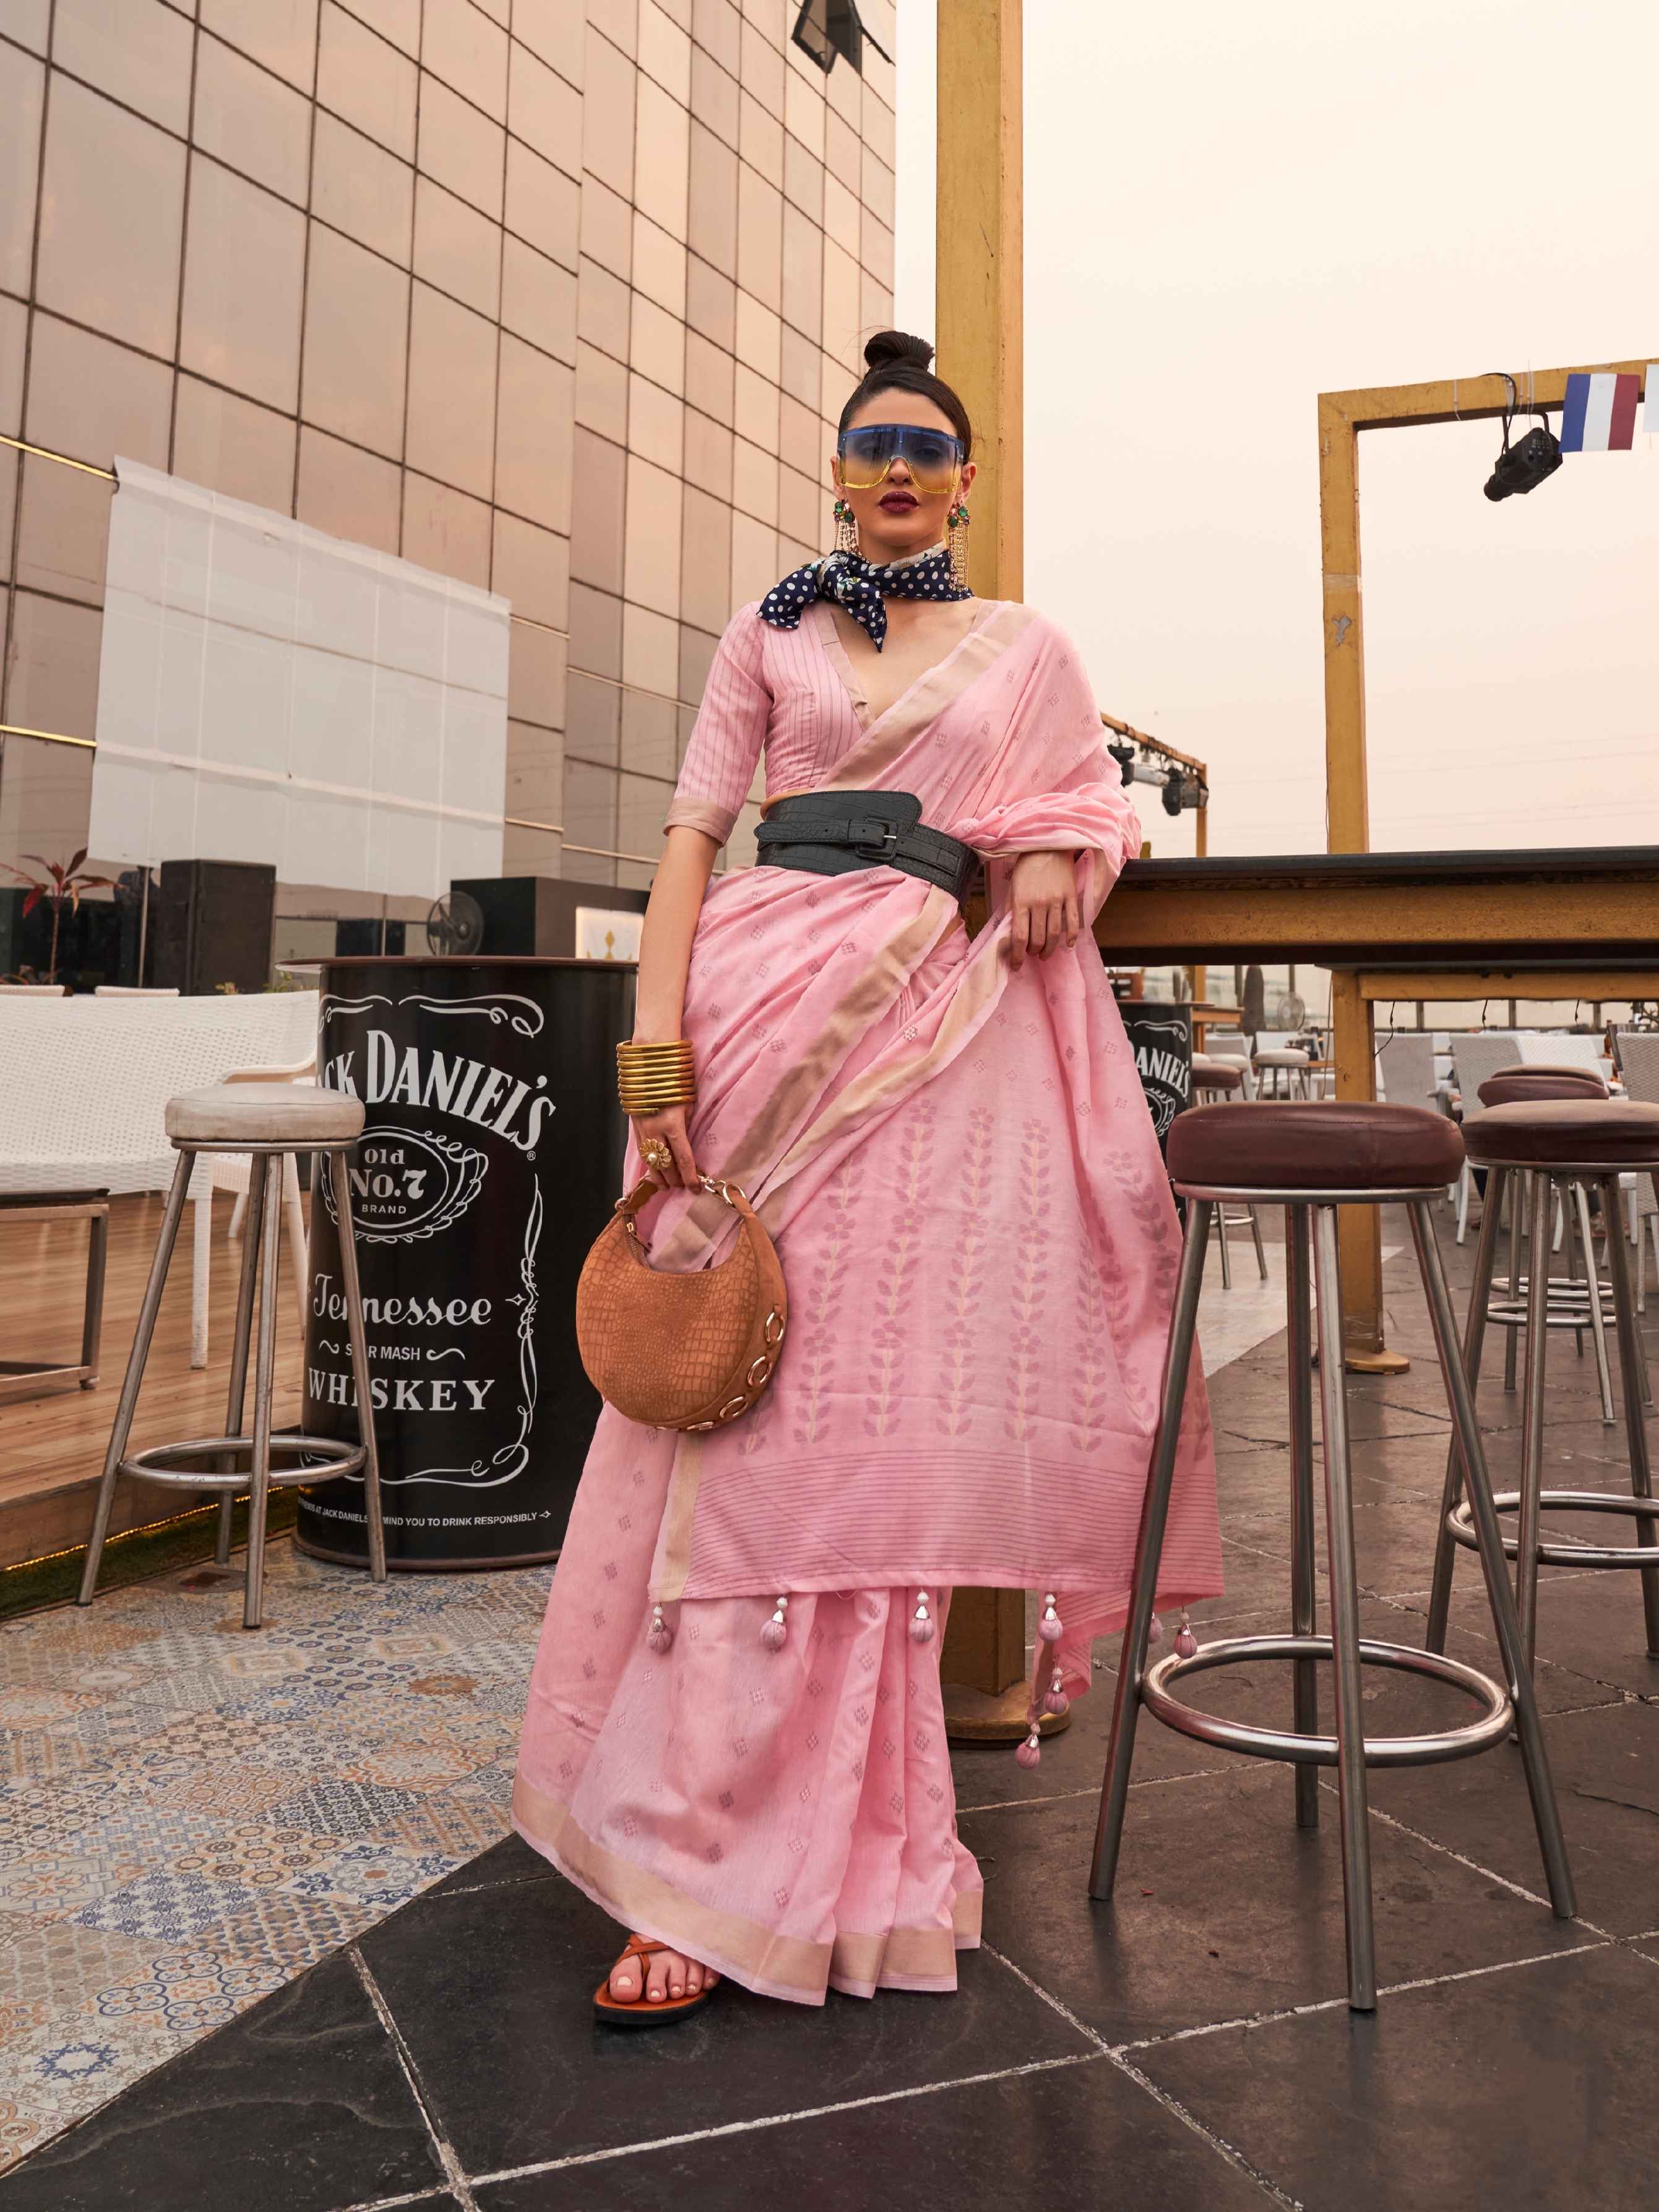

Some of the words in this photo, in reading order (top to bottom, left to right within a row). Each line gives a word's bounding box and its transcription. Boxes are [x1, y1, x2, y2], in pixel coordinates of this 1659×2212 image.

[1129, 1040, 1189, 1098] ANIEL'S
[365, 1030, 556, 1151] DANIEL'S
[362, 1204, 407, 1214] BRAND
[345, 1343, 377, 1359] SR
[381, 1346, 420, 1361] MASH
[322, 1508, 338, 1518] JACK
[382, 1516, 403, 1525] MIND
[406, 1518, 425, 1526] YOU
[428, 1518, 440, 1526] TO
[442, 1517, 472, 1526] DRINK
[474, 1512, 537, 1525] RESPONSIBLY
